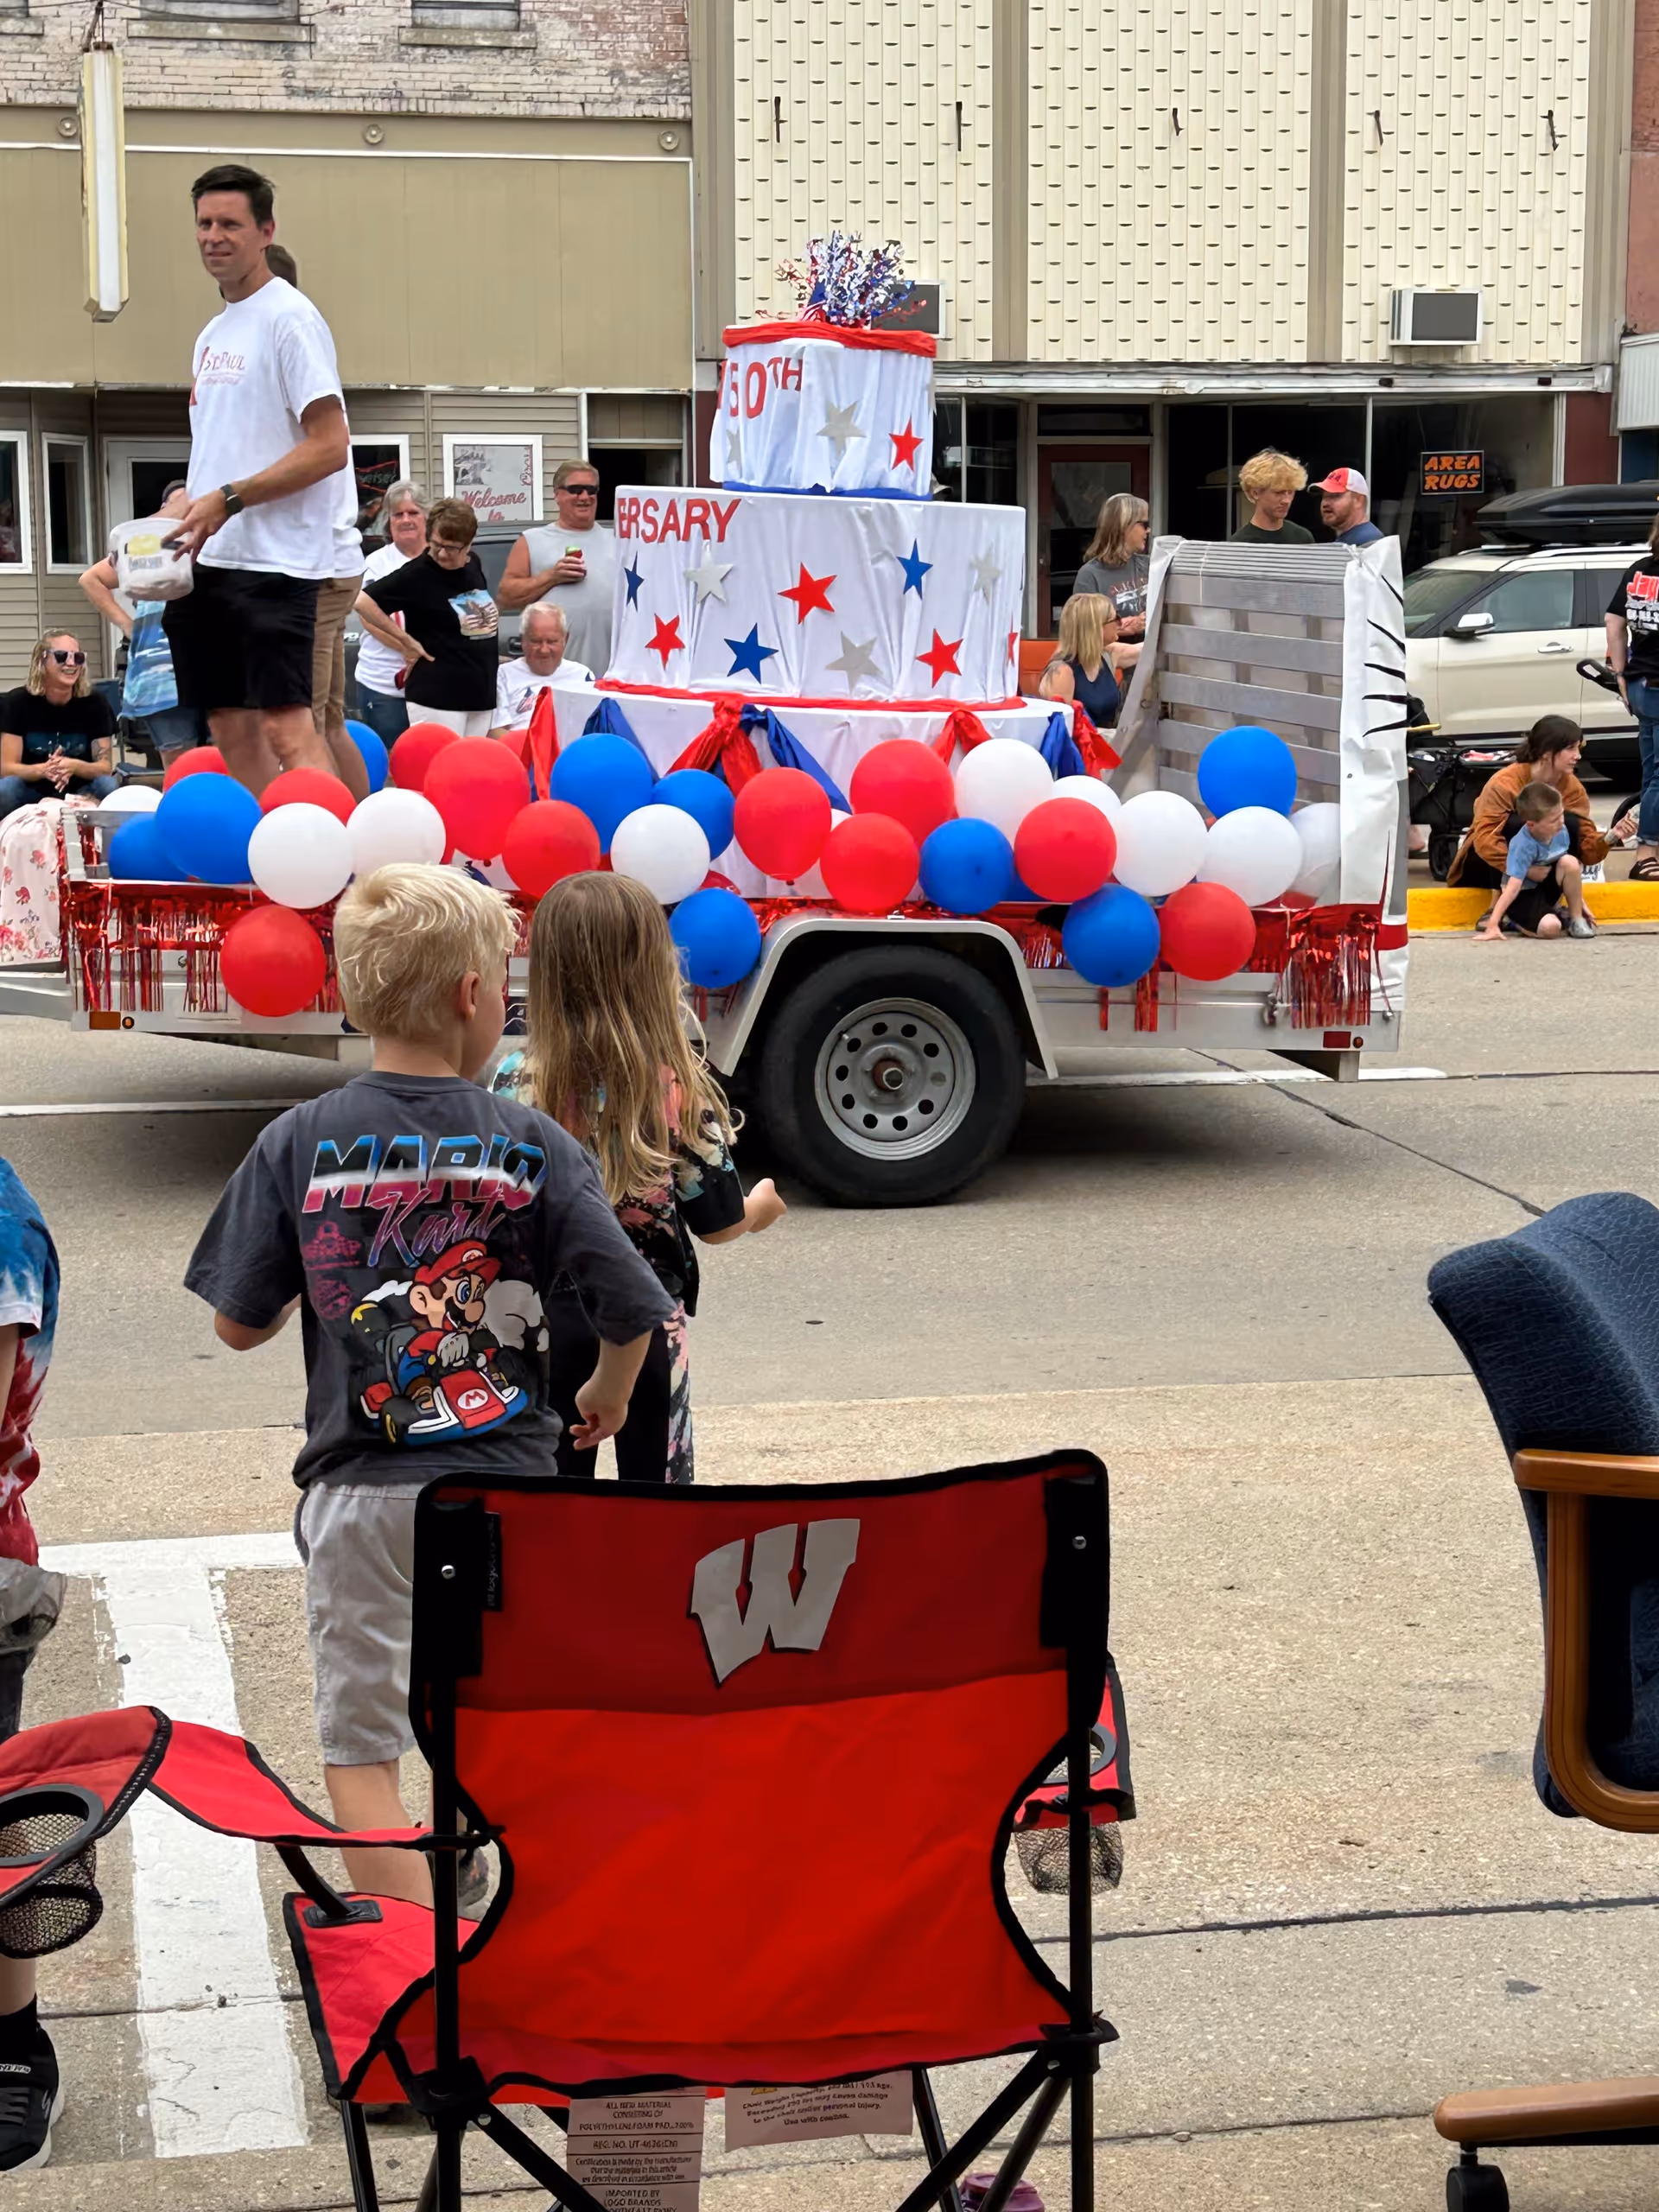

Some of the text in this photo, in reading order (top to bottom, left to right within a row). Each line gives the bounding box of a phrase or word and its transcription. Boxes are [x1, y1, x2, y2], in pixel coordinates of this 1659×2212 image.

[1423, 474, 1481, 491] RUGS
[1424, 454, 1481, 471] AREA
[461, 486, 527, 509] Welcome
[617, 497, 742, 543] ERSARY
[302, 1134, 548, 1213] MARIO
[366, 1187, 506, 1268] Kart
[687, 1518, 861, 1689] W
